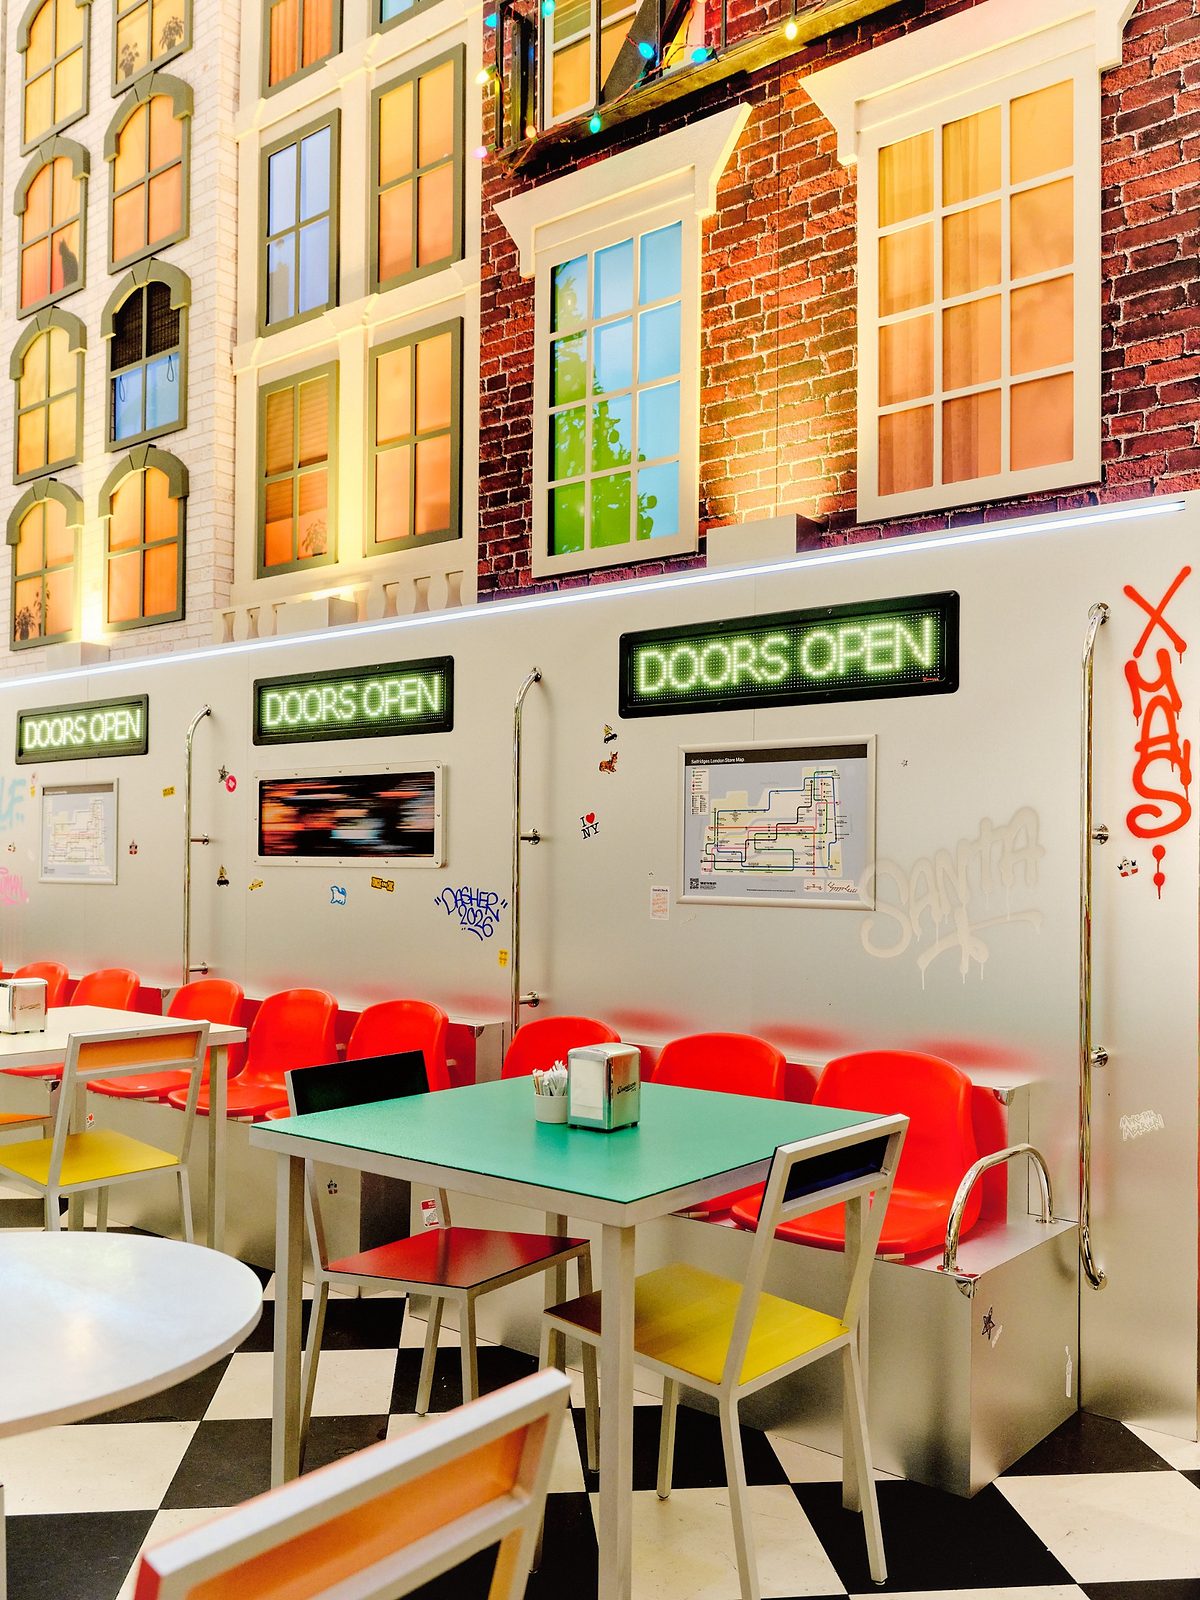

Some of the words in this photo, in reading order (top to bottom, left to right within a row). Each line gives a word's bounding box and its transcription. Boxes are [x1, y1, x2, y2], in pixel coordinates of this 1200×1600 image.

[638, 635, 790, 694] DOORS
[801, 615, 934, 677] OPEN
[265, 684, 357, 726] DOORS
[362, 674, 440, 717] OPEN
[23, 714, 88, 750] DOORS
[89, 708, 141, 743] OPEN
[581, 822, 601, 840] NY
[859, 805, 1047, 959] SANTA
[457, 903, 494, 938] 2026
